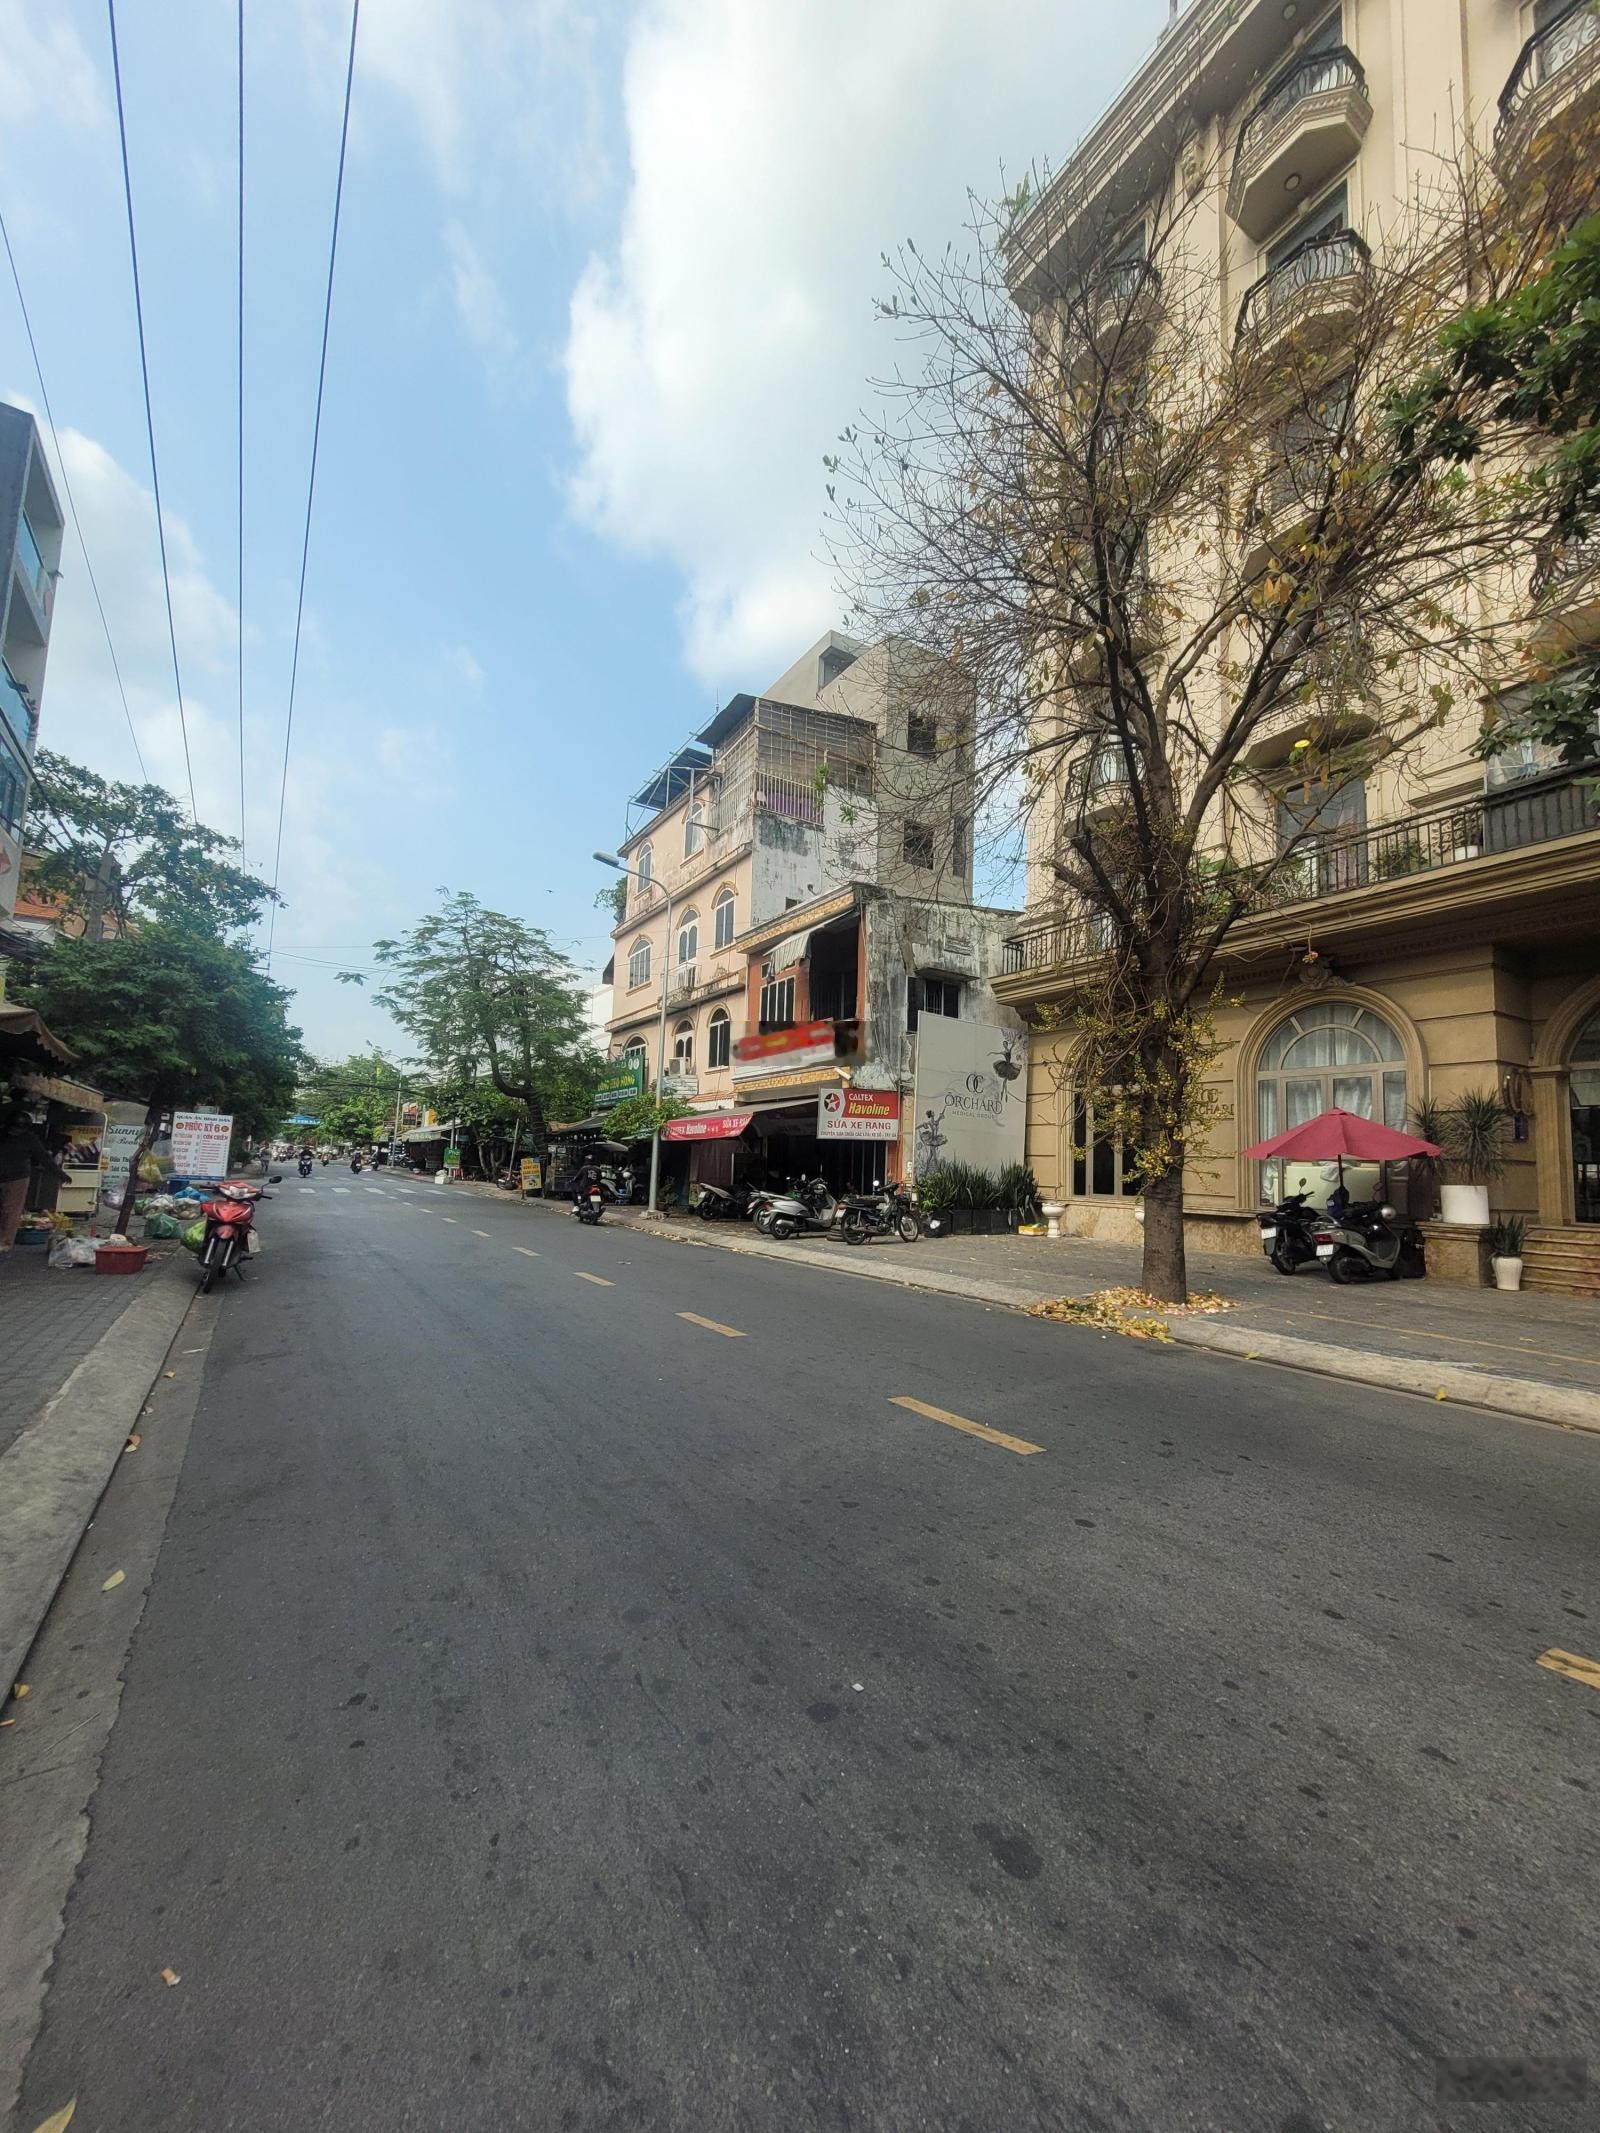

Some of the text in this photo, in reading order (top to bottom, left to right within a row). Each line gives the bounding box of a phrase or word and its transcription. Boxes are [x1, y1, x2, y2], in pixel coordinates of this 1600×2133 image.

[848, 1093, 874, 1102] CALTEX
[944, 1091, 1003, 1115] ORCHARD
[848, 1102, 890, 1116] Havoline
[952, 1110, 975, 1118] MEDICAL
[214, 1124, 221, 1133] 6
[850, 1121, 863, 1129] XE
